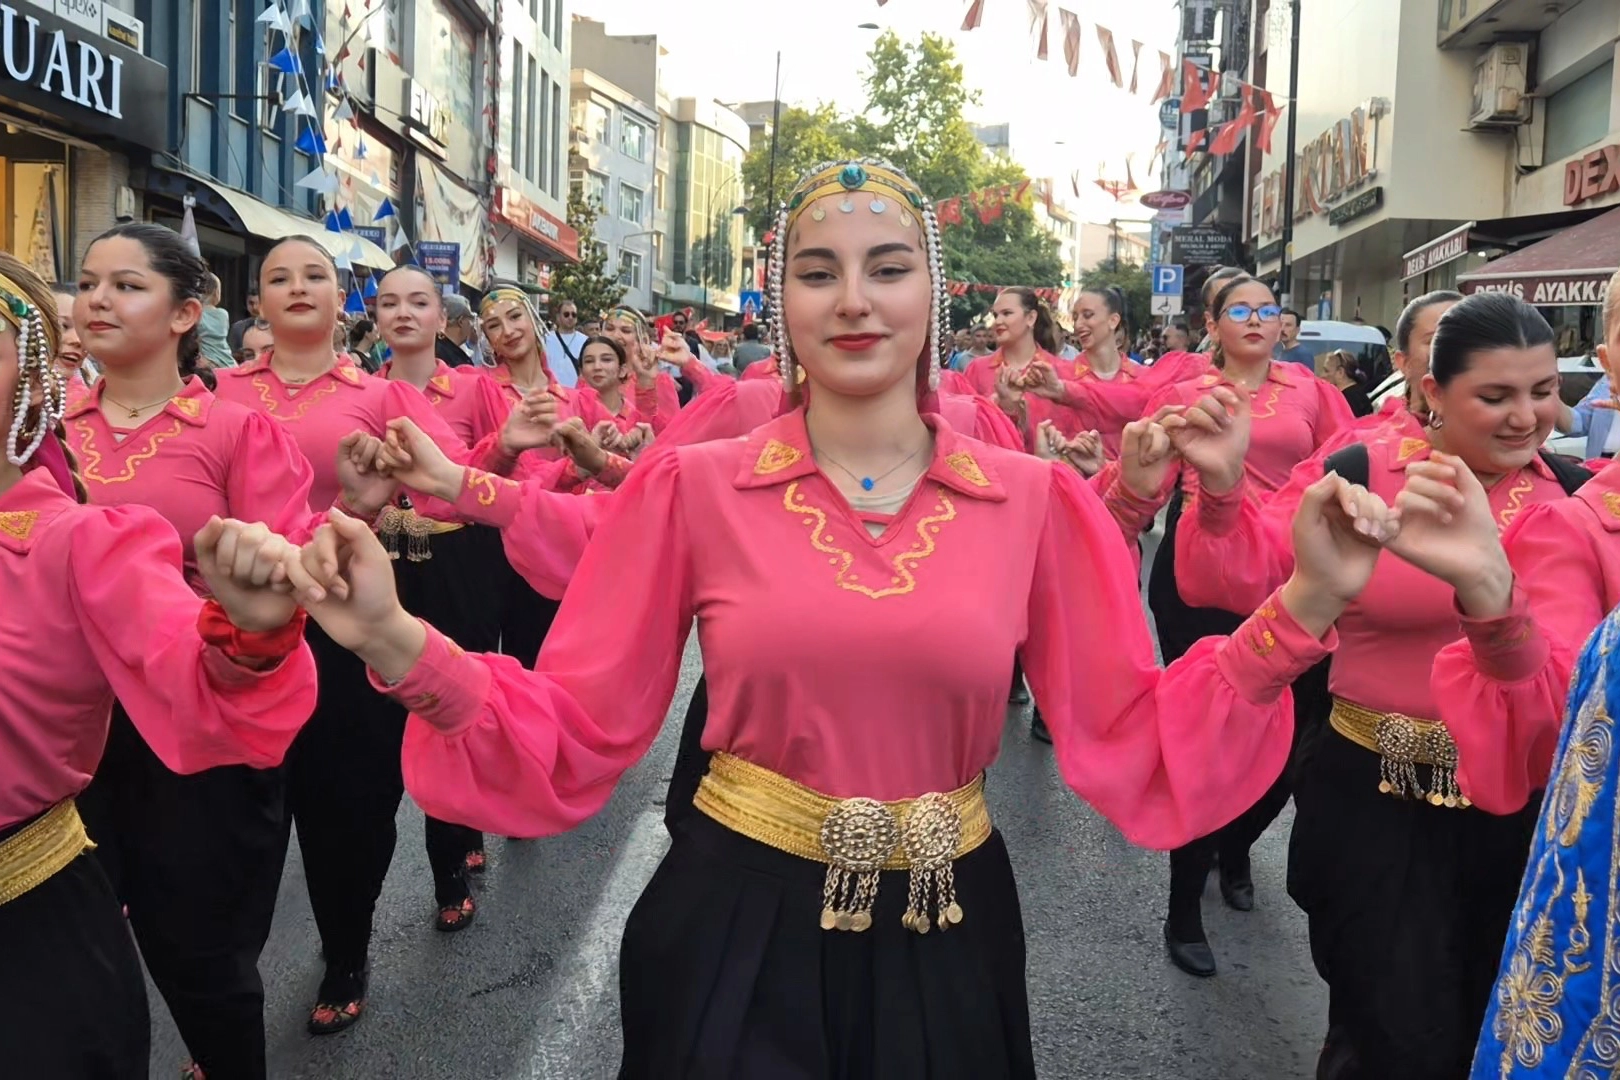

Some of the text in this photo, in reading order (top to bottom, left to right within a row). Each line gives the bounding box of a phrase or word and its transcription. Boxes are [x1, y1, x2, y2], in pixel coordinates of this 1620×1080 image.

[0, 3, 123, 119] UARI
[1563, 145, 1620, 206] DEX
[1174, 235, 1232, 243] MERAL MODA
[1427, 236, 1462, 265] AYAKKABI
[1159, 268, 1177, 292] P
[1533, 280, 1608, 302] AYAKKA
